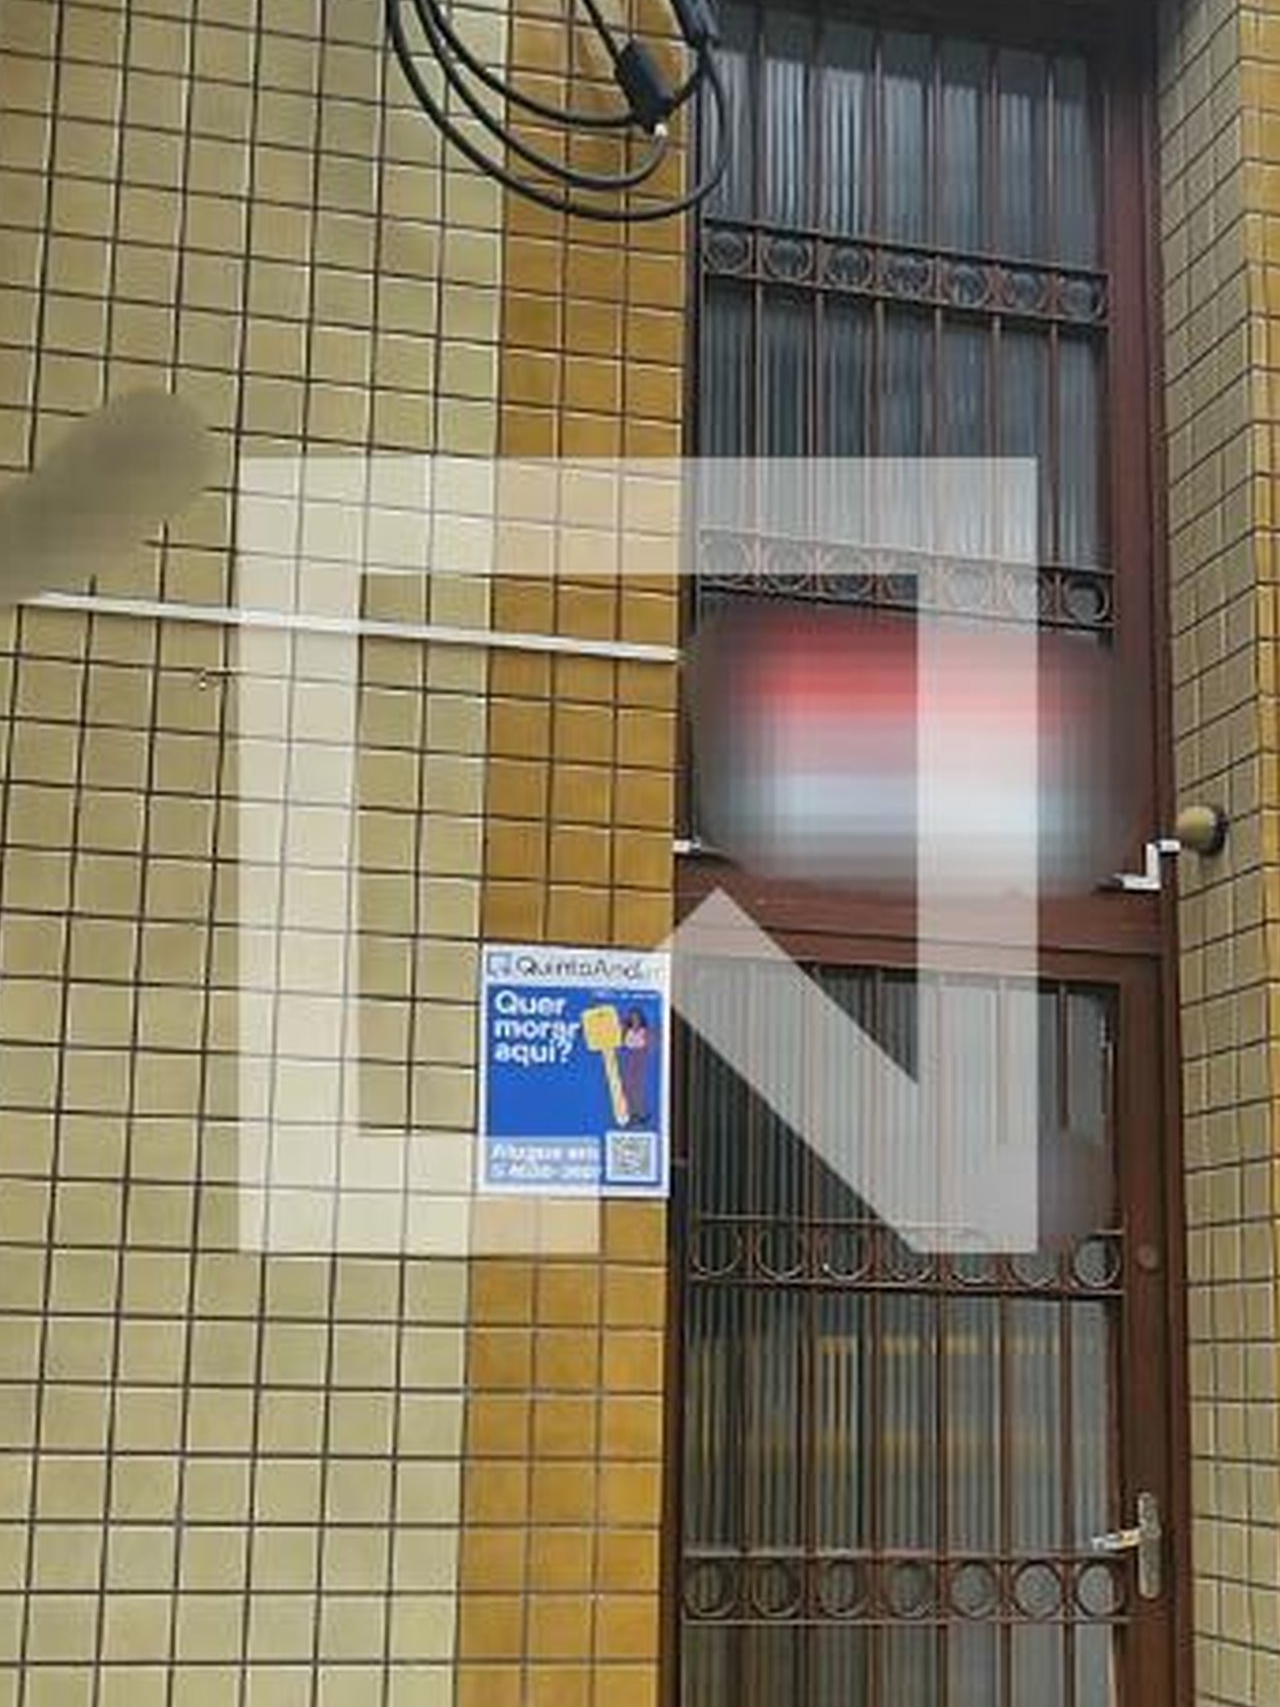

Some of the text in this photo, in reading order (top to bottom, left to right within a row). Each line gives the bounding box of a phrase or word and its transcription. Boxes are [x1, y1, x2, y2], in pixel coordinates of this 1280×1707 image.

[494, 989, 567, 1016] Quer
[494, 1017, 582, 1043] morar
[494, 1040, 573, 1068] aqui?
